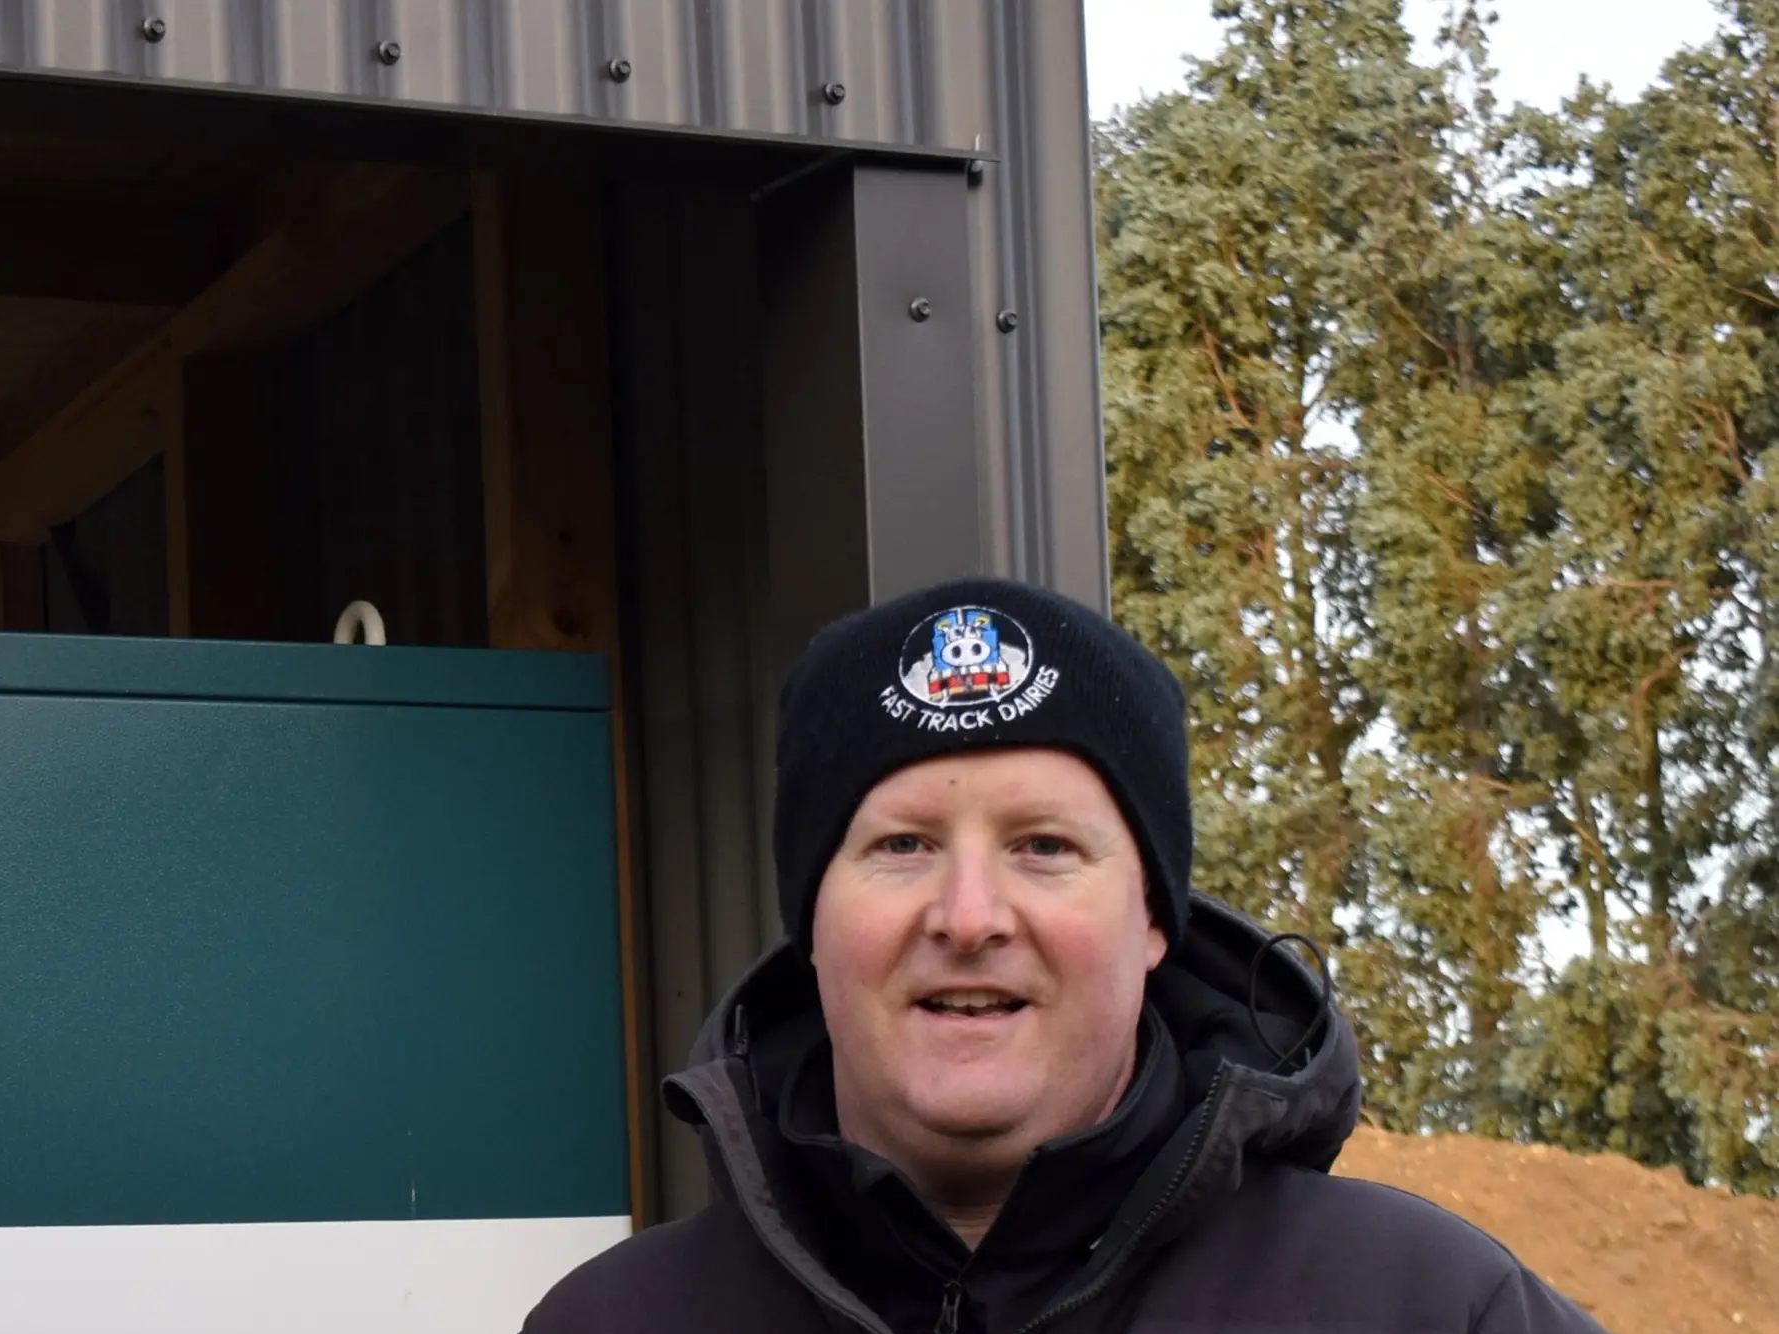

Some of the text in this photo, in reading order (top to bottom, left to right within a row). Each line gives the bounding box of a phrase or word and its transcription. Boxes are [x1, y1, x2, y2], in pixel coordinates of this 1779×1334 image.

[878, 664, 1060, 732] FAST TRACK DAIRIES
